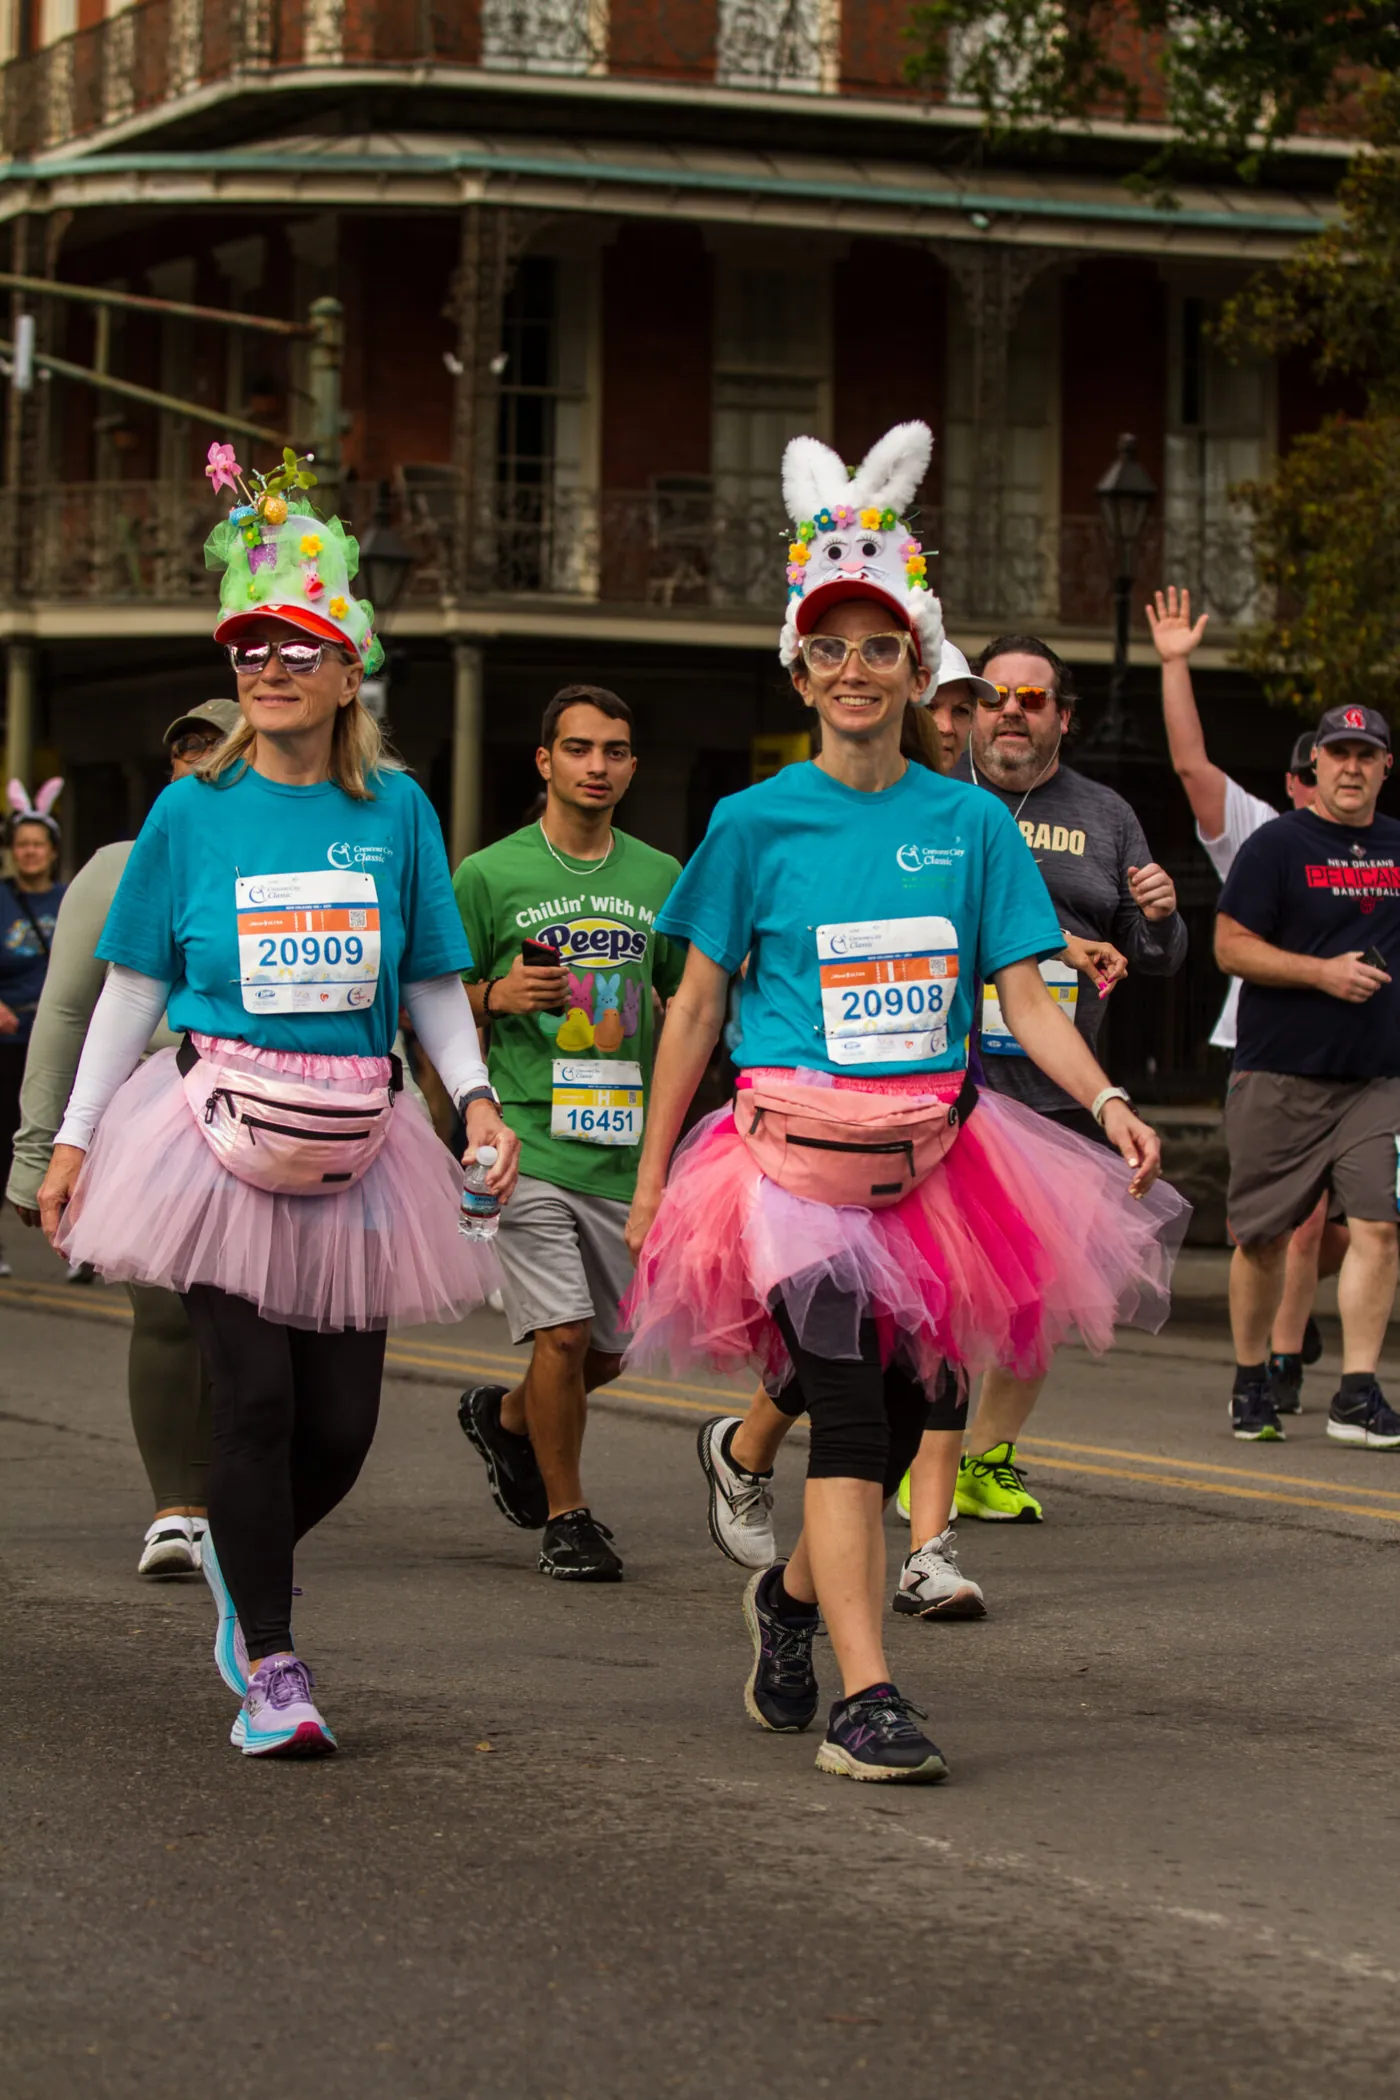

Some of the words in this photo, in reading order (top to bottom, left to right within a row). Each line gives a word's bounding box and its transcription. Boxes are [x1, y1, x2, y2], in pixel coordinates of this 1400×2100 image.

[354, 852, 385, 863] Classic
[924, 855, 953, 866] Classic
[949, 848, 965, 857] City
[1327, 858, 1349, 867] NEW
[1332, 887, 1400, 897] BASKETBALL
[590, 896, 635, 918] With
[537, 924, 648, 962] Peeps
[258, 936, 363, 967] 20909
[842, 984, 943, 1020] 20908
[567, 1109, 633, 1132] 16451
